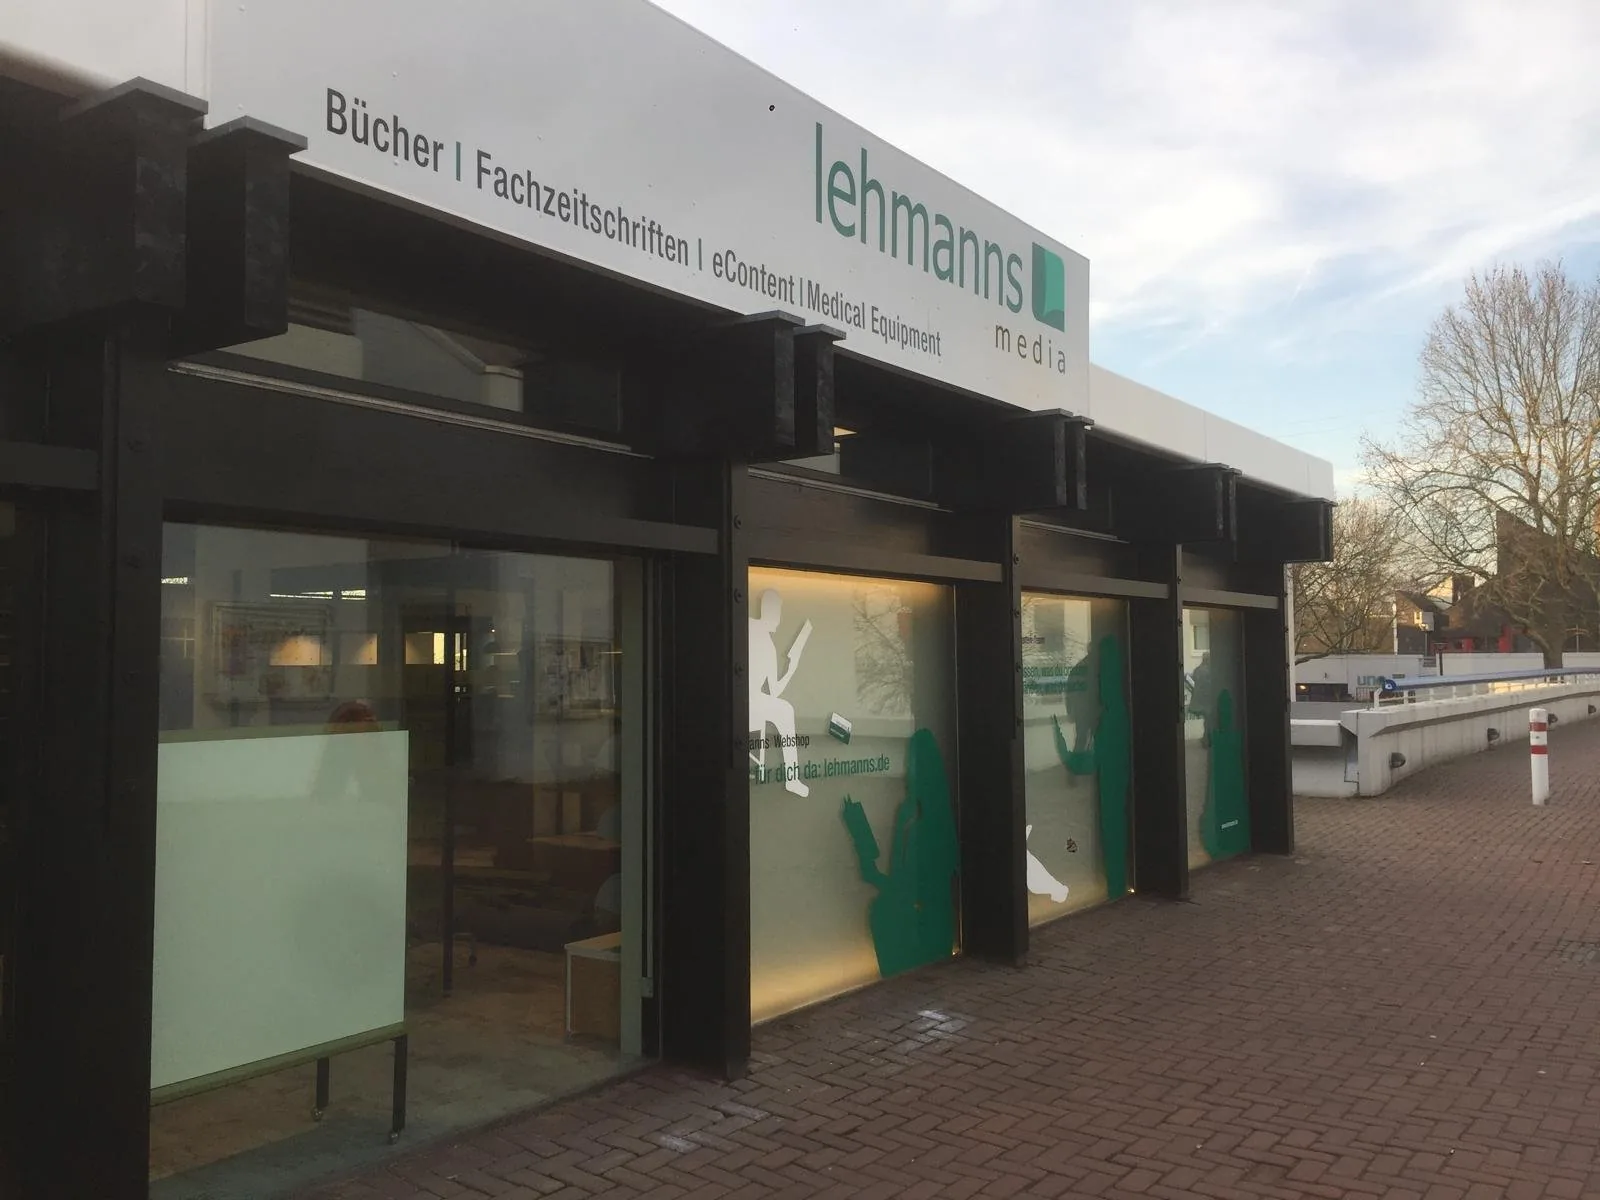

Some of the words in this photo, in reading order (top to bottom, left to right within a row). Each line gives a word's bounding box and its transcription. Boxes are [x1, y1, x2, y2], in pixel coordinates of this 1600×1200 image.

[326, 87, 444, 172] Bücher
[476, 149, 689, 267] Fachzeitschriften
[712, 249, 795, 305] eContent
[807, 279, 866, 331] Medical
[871, 306, 942, 357] Equipment
[815, 121, 1023, 314] lehmanns
[995, 321, 1065, 375] media
[749, 737, 770, 750] anns
[773, 733, 810, 749] Webshop
[776, 761, 800, 783] dich
[804, 759, 821, 780] da:
[824, 753, 890, 778] lehmanns.de
